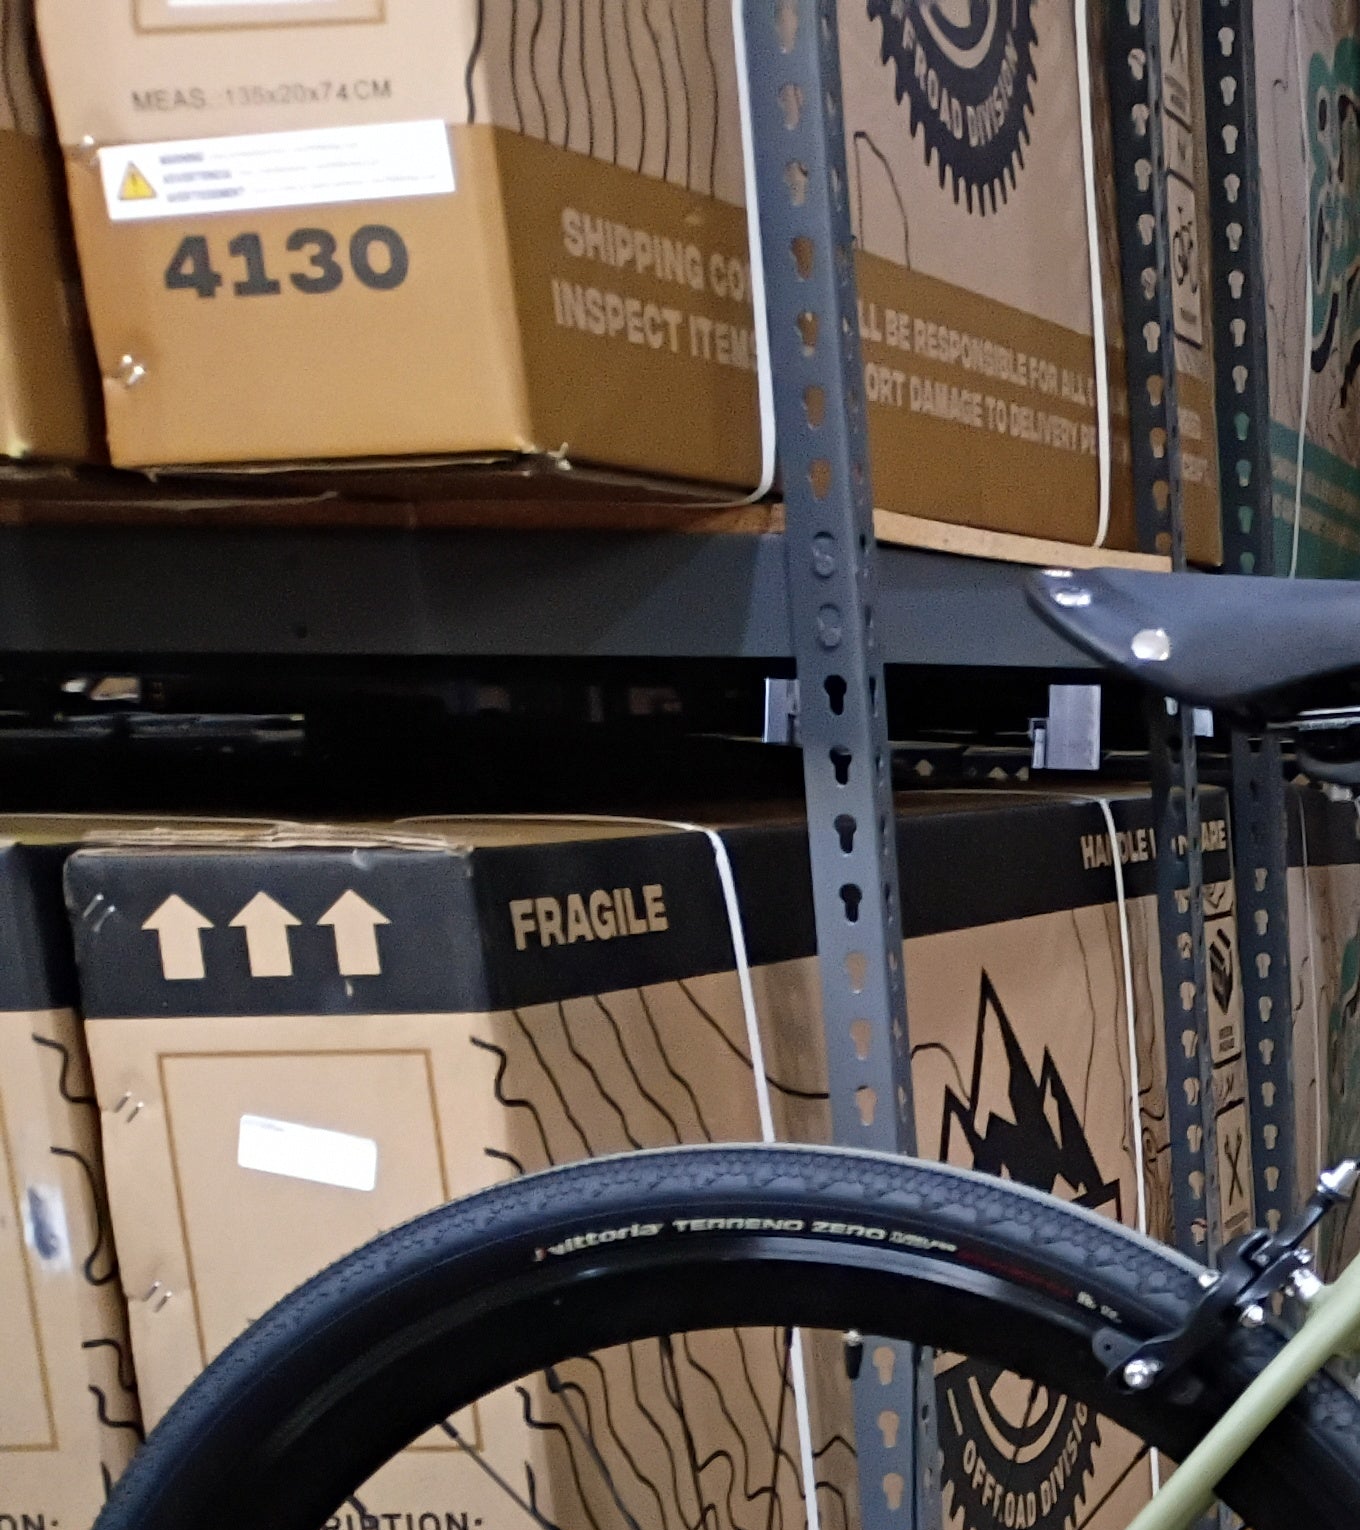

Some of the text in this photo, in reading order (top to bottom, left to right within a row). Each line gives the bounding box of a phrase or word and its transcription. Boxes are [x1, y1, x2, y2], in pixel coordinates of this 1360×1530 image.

[164, 223, 410, 299] 4130
[561, 206, 705, 290] SHIPPING
[552, 276, 757, 372] INSPECT ITEM
[885, 308, 911, 351] BE
[985, 393, 1008, 435] TO
[509, 884, 669, 951] FRAGILE
[546, 1217, 887, 1256] vittoria TERRENO ZERO
[1040, 1401, 1088, 1517] DIVISIO
